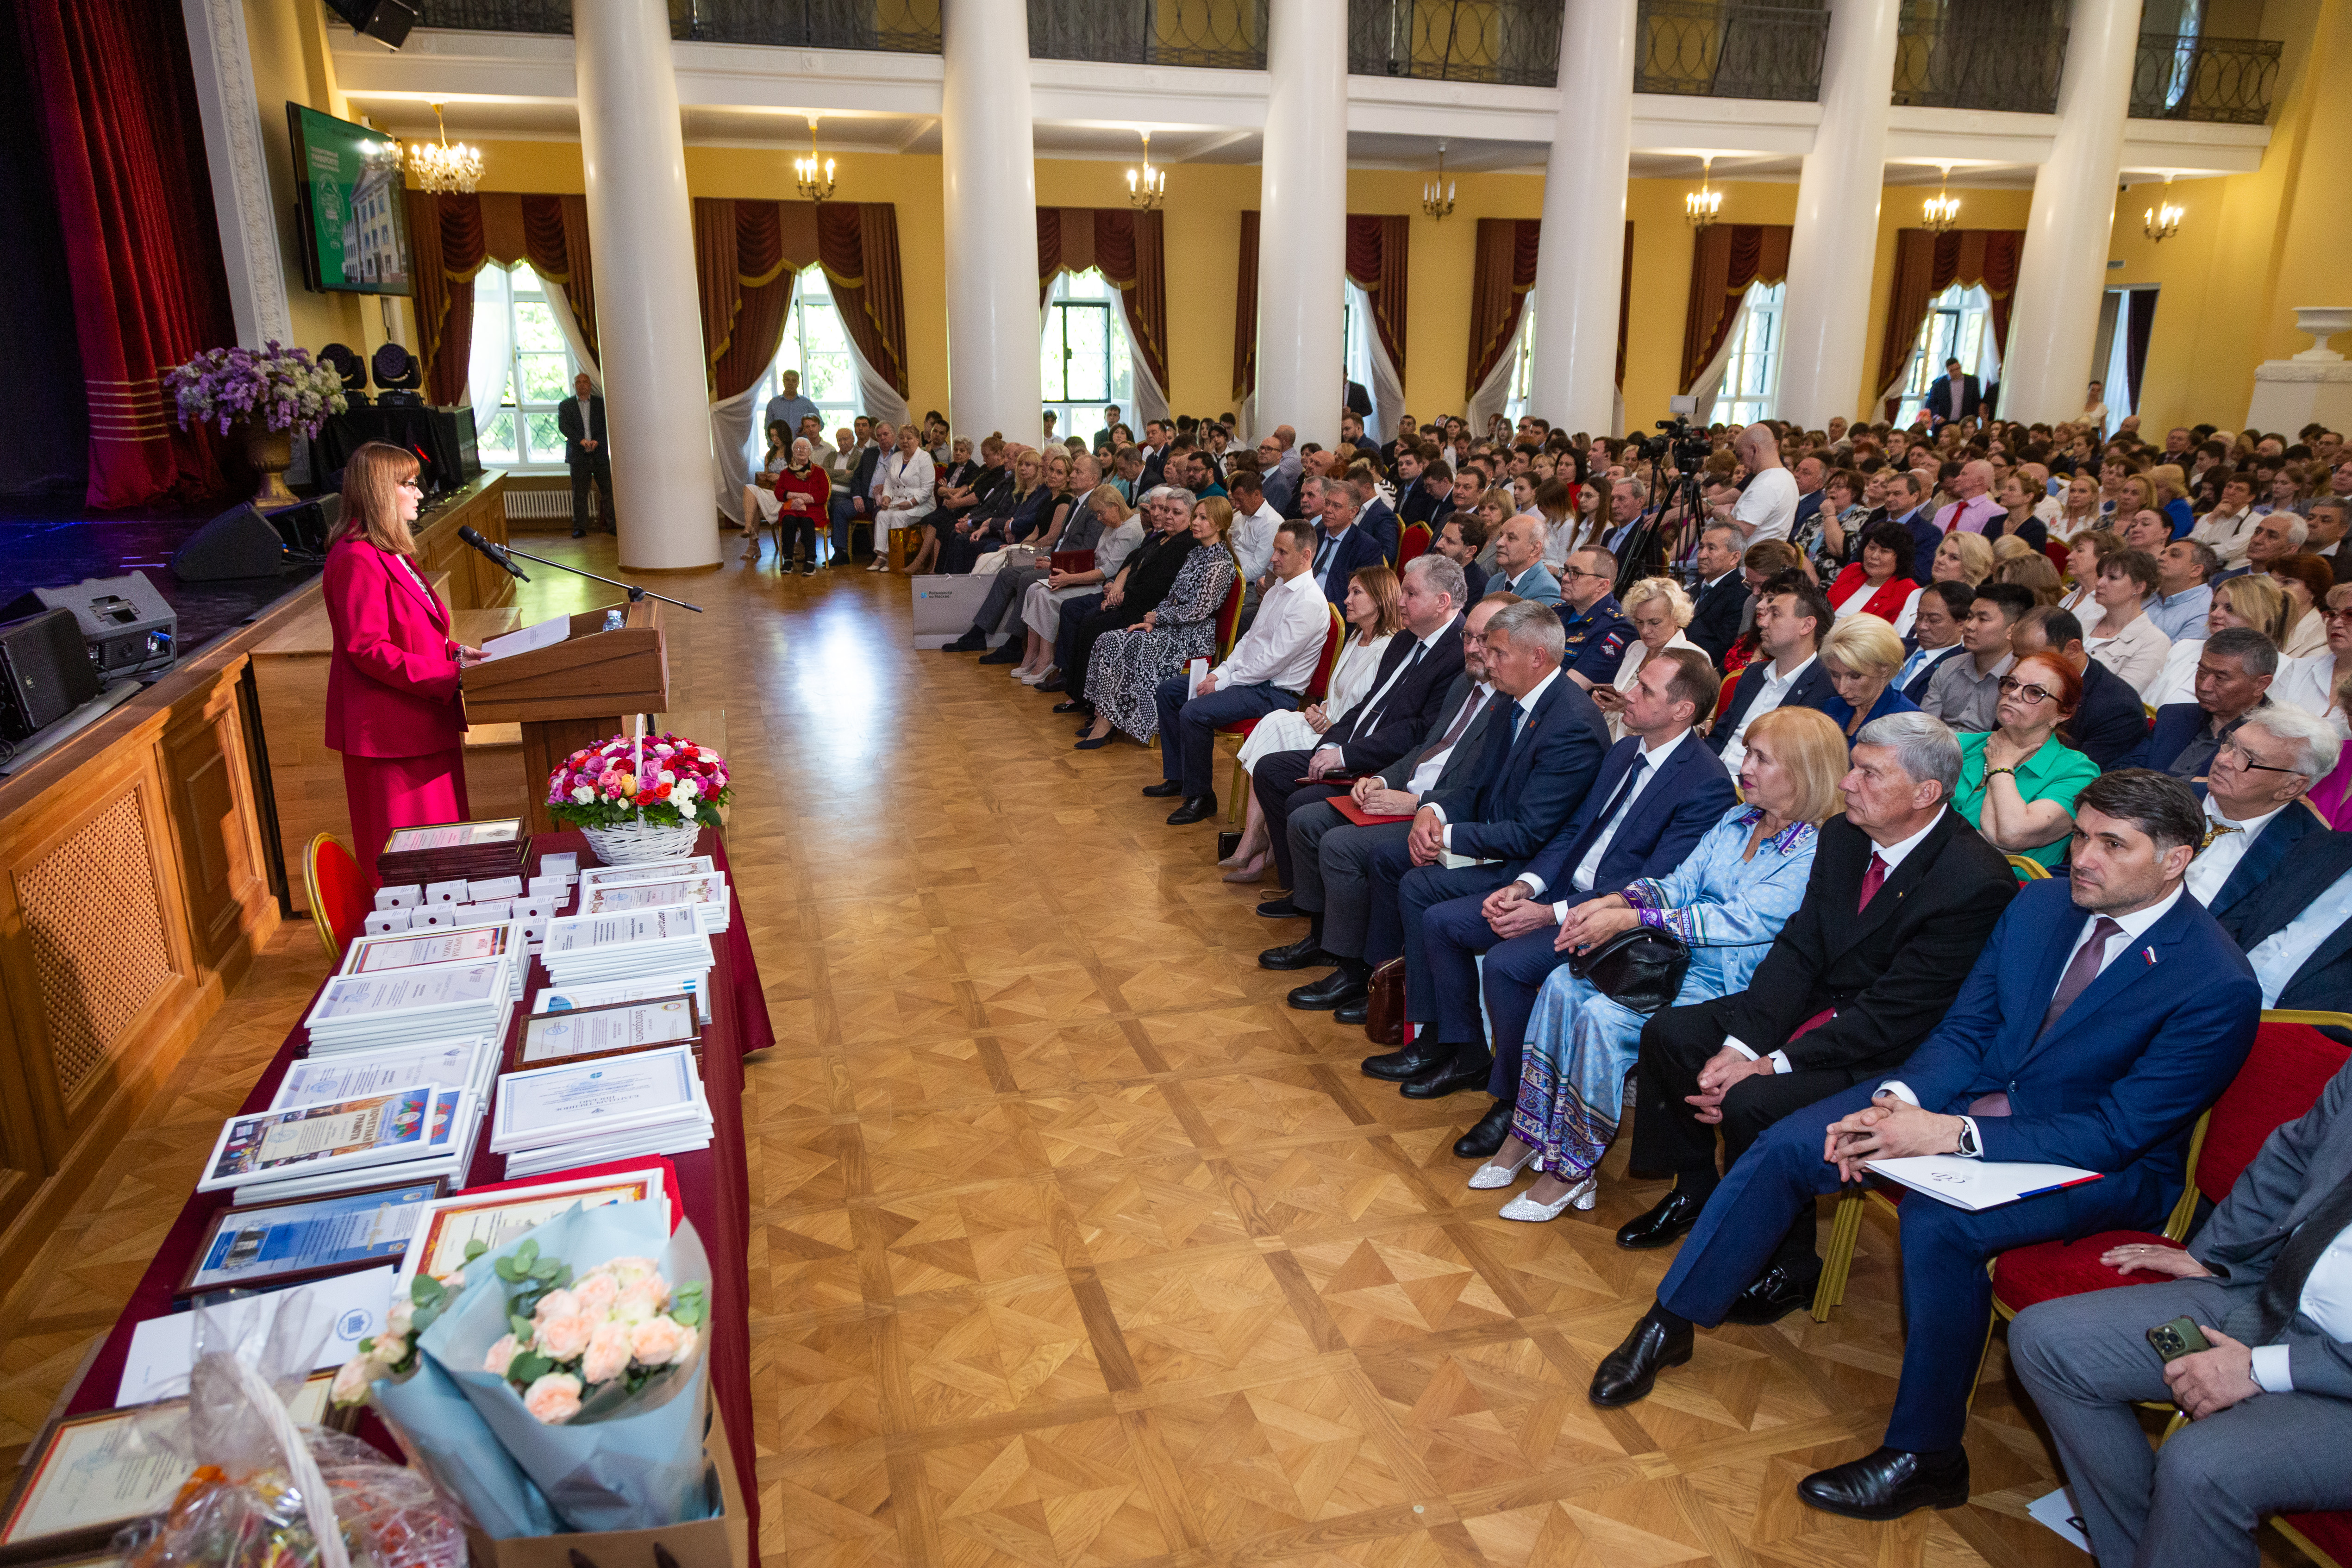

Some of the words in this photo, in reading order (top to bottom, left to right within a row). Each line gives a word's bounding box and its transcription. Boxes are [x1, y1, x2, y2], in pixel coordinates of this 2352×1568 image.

[442, 940, 452, 957] ГРАМОТА
[453, 937, 463, 957] ПОЧЕТНАЯ
[632, 1010, 646, 1043] Благодарность
[350, 1113, 365, 1141] ГРАМОТА
[365, 1108, 380, 1142] ПОЧЕТНАЯ
